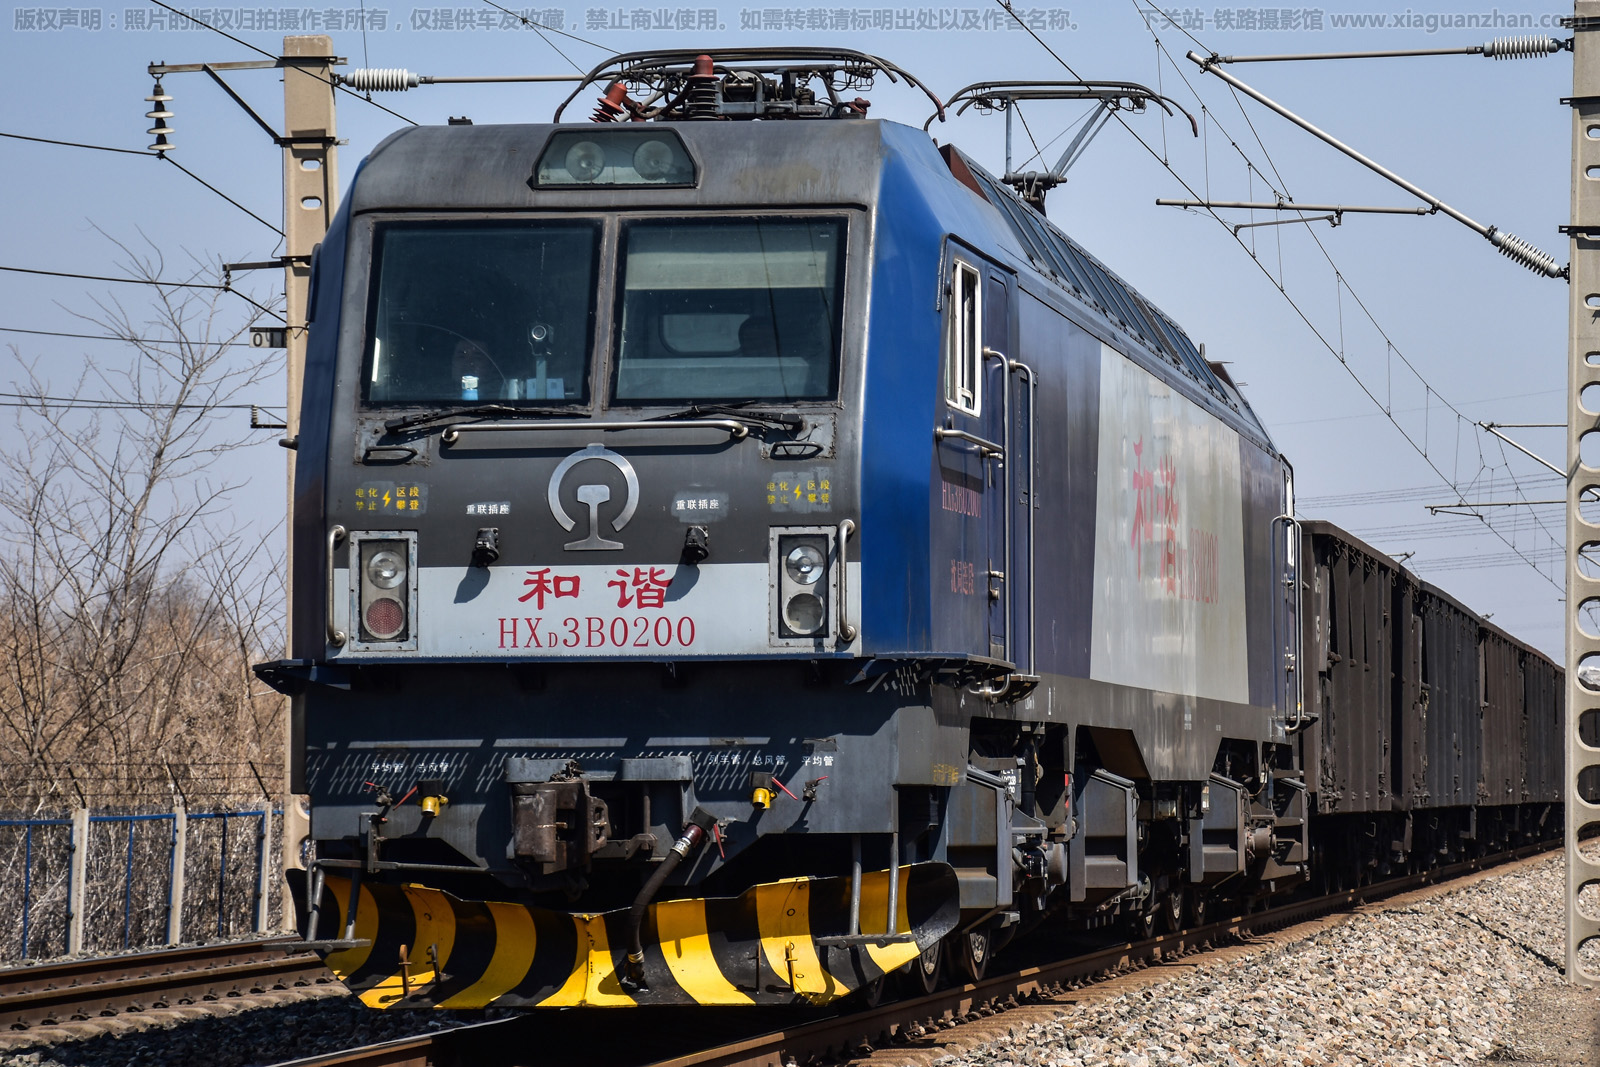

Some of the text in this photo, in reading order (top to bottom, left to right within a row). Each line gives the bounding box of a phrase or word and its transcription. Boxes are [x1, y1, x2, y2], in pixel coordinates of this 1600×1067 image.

[355, 486, 419, 498] 电化 区段
[766, 480, 830, 492] 电化 区段
[466, 504, 510, 515] 重联插座
[676, 499, 719, 510] 重联插座
[1130, 434, 1179, 596] 和谐
[518, 566, 674, 610] 和谐
[498, 616, 696, 649] HXD3B0200
[708, 754, 834, 766] 列车管 总风管 平均管
